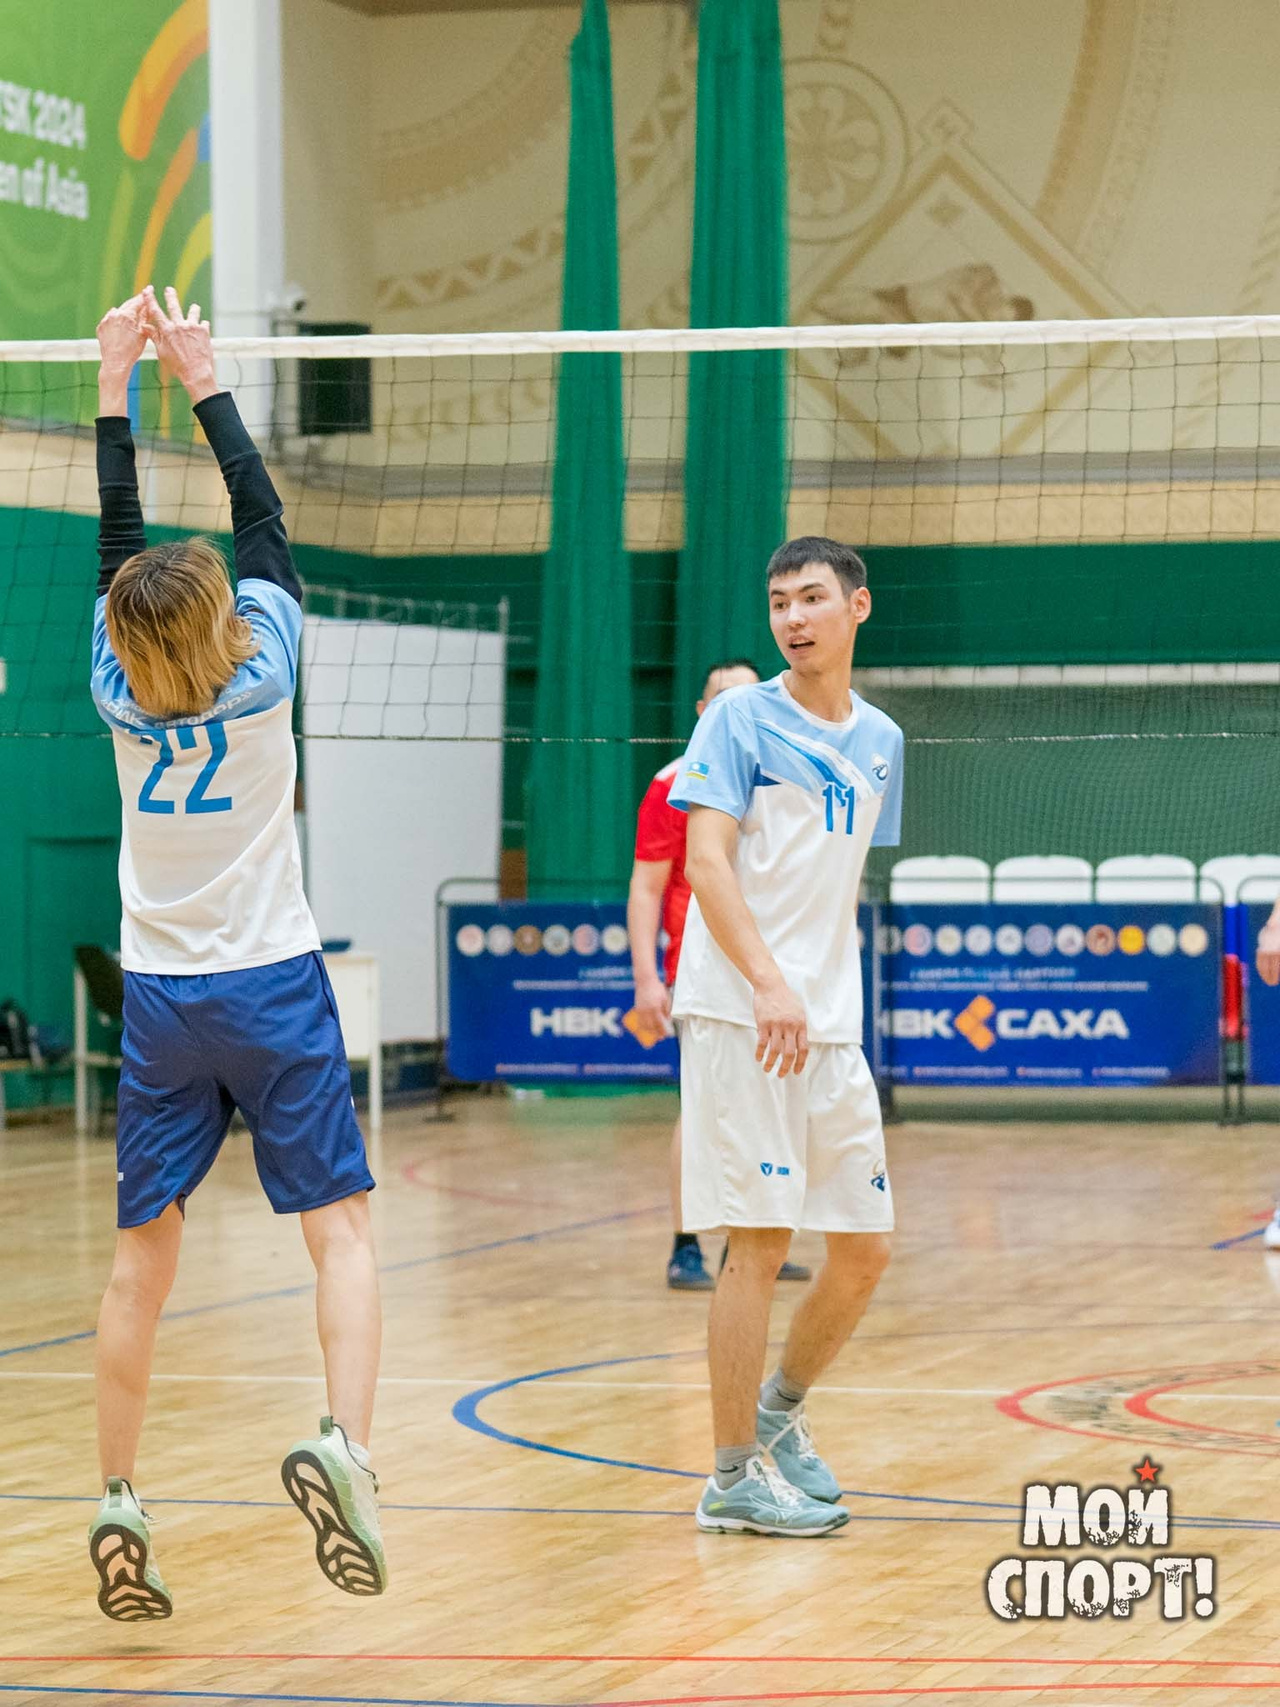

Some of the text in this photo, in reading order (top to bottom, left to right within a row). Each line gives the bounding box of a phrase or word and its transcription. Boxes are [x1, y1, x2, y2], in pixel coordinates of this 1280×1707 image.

[33, 90, 86, 149] 2024
[22, 157, 44, 208] of
[45, 161, 88, 220] Asia
[132, 722, 232, 814] 22
[822, 781, 855, 835] 11
[996, 1008, 1130, 1039] САХА
